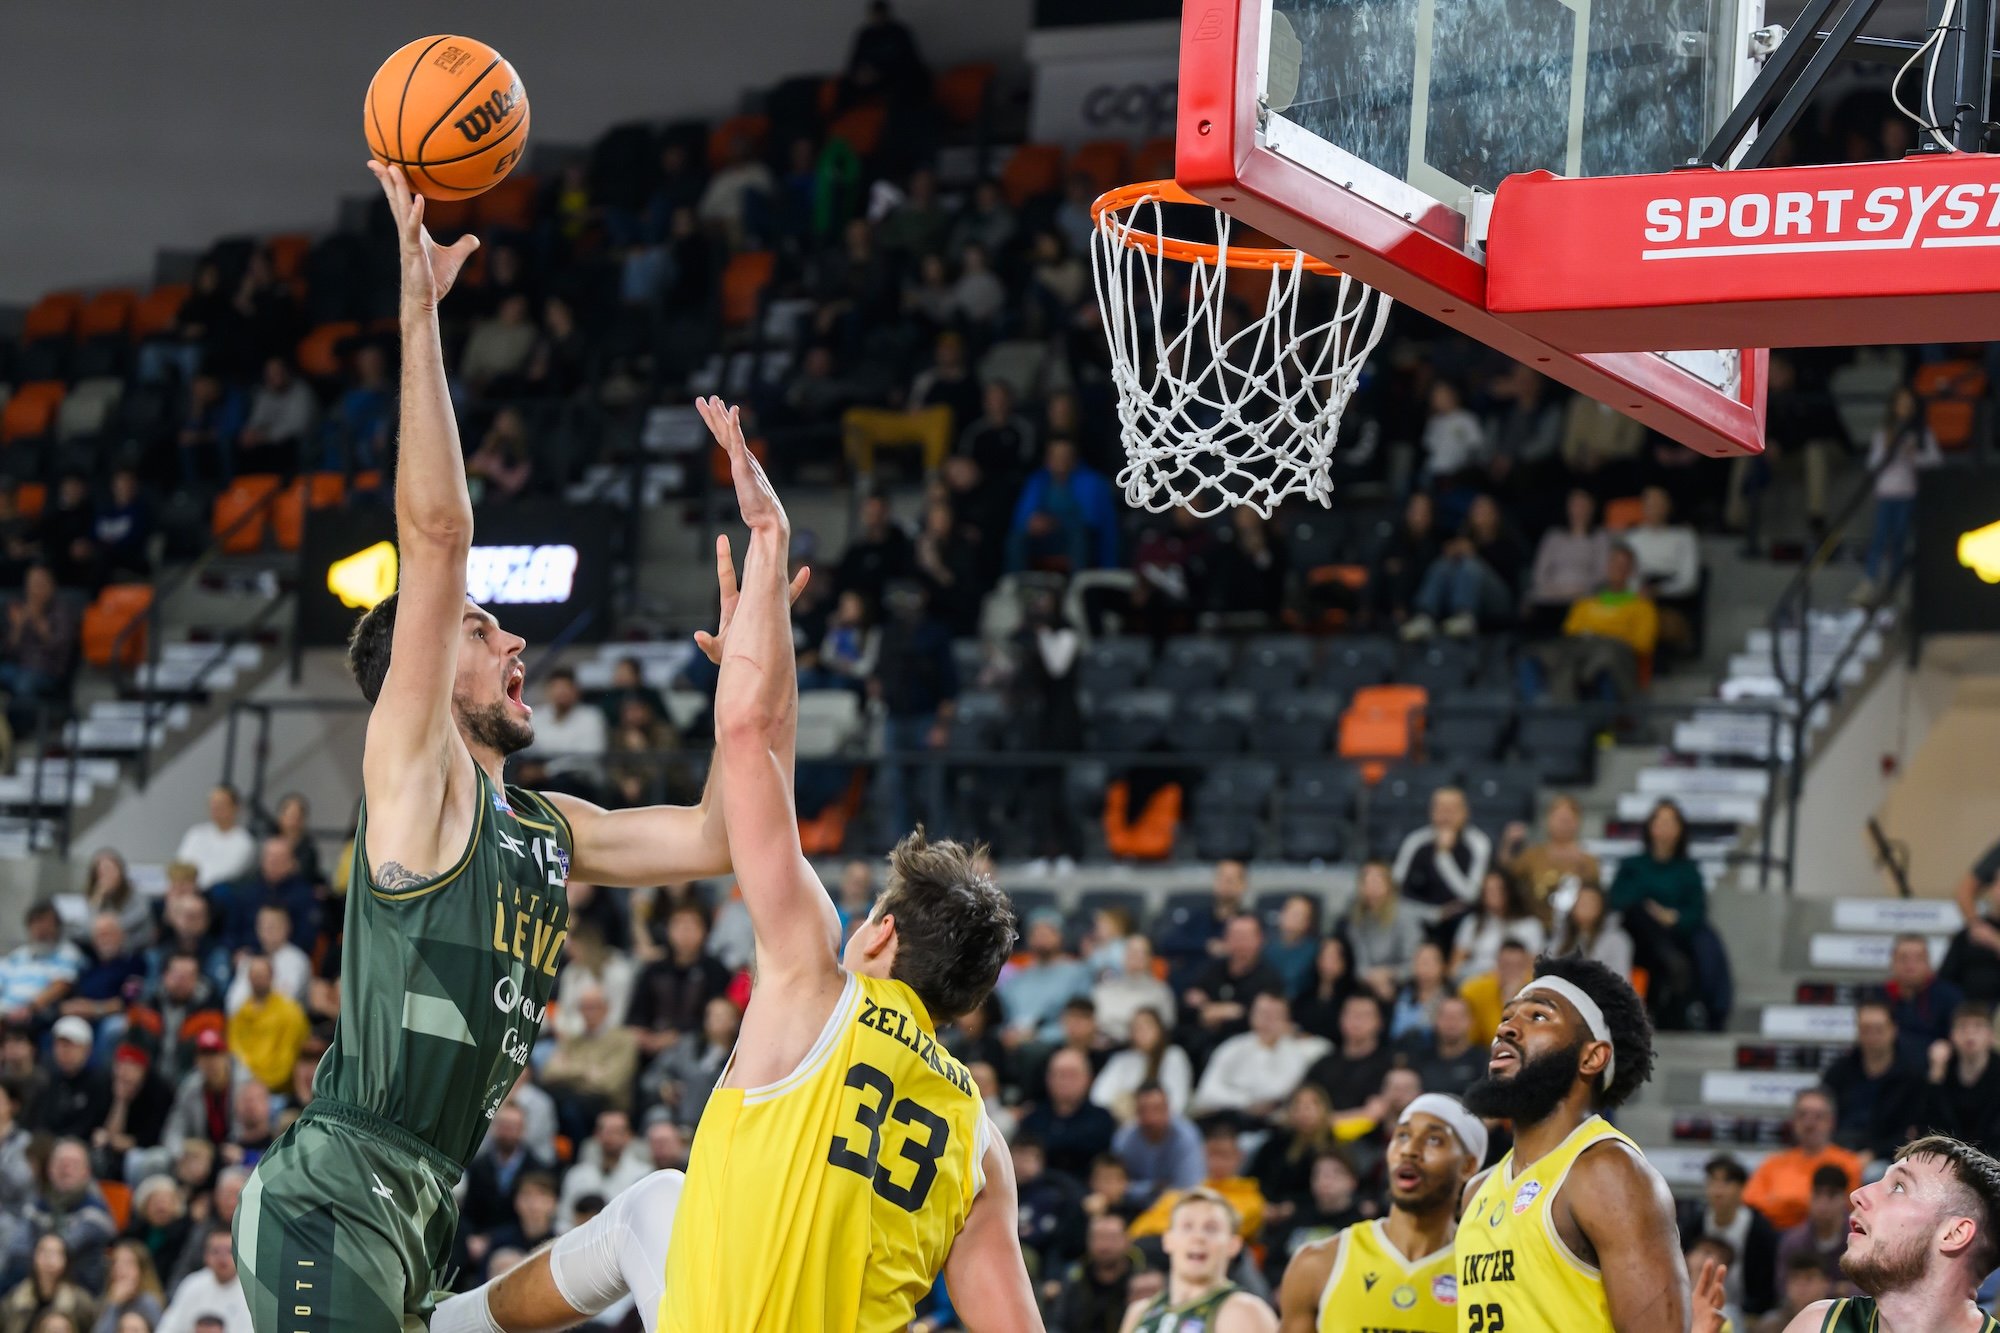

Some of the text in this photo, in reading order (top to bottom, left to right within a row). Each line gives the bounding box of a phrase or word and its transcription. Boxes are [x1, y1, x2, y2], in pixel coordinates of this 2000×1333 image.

[1644, 189, 1854, 242] SPORT
[827, 1062, 950, 1213] 33
[1462, 1249, 1515, 1286] INTER
